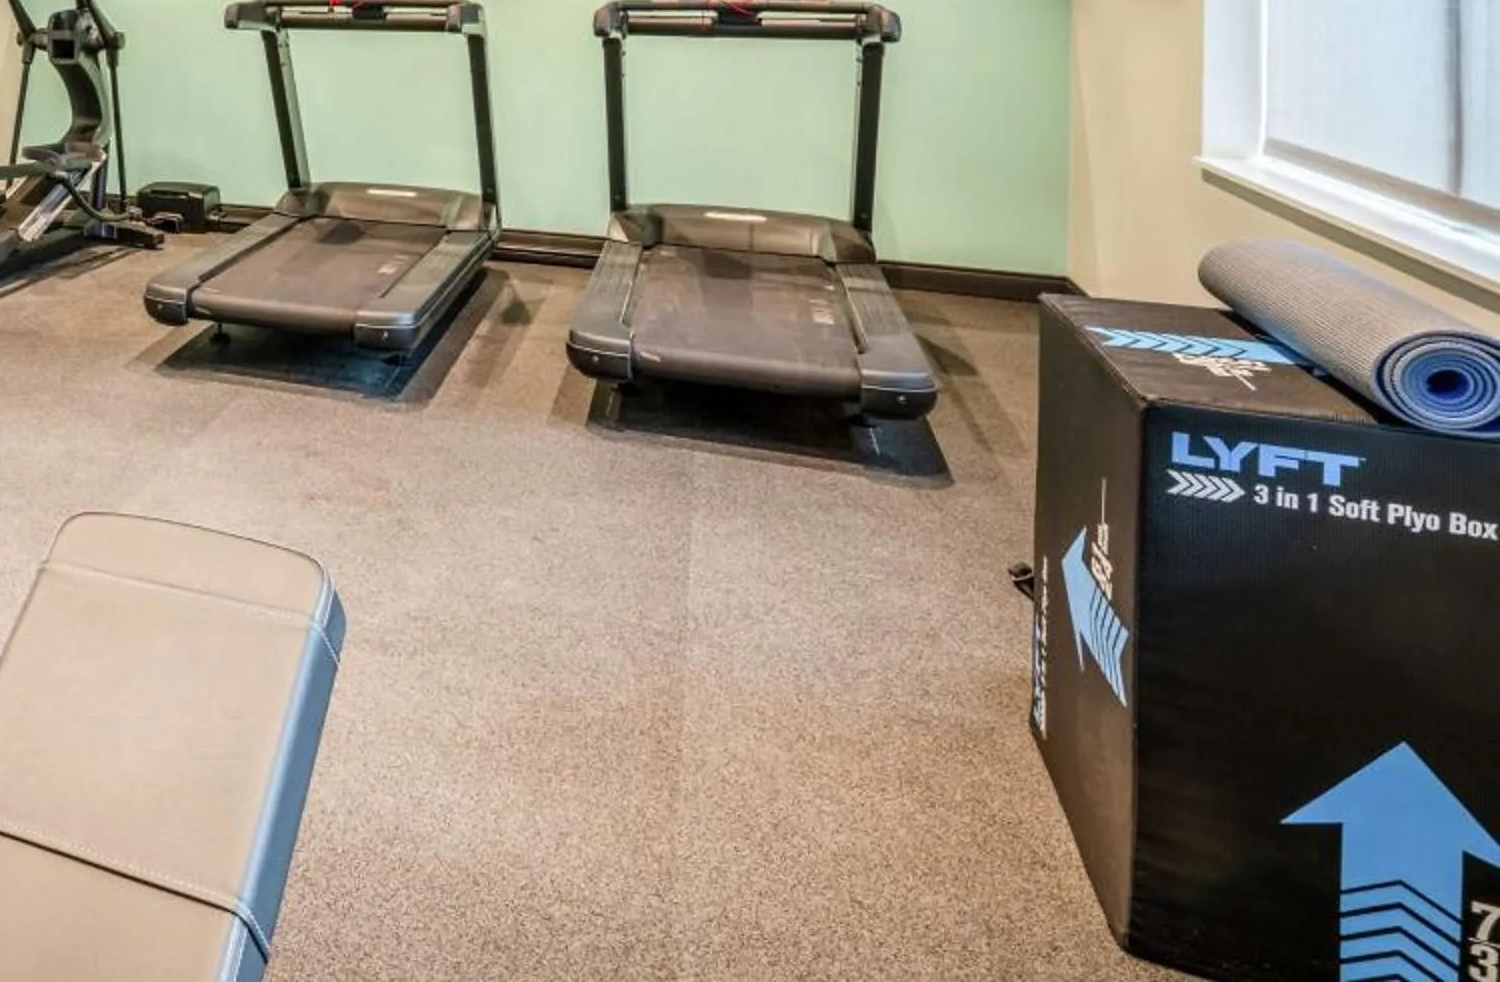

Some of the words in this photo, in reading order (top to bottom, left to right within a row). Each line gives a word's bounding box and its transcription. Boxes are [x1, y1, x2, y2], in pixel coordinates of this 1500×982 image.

[1172, 431, 1360, 487] LYFT
[1253, 483, 1269, 505] 3
[1276, 486, 1299, 510] in
[1306, 492, 1318, 513] 1
[1328, 493, 1380, 523] Soft
[1386, 501, 1441, 533] Plyo
[1448, 511, 1499, 541] Box
